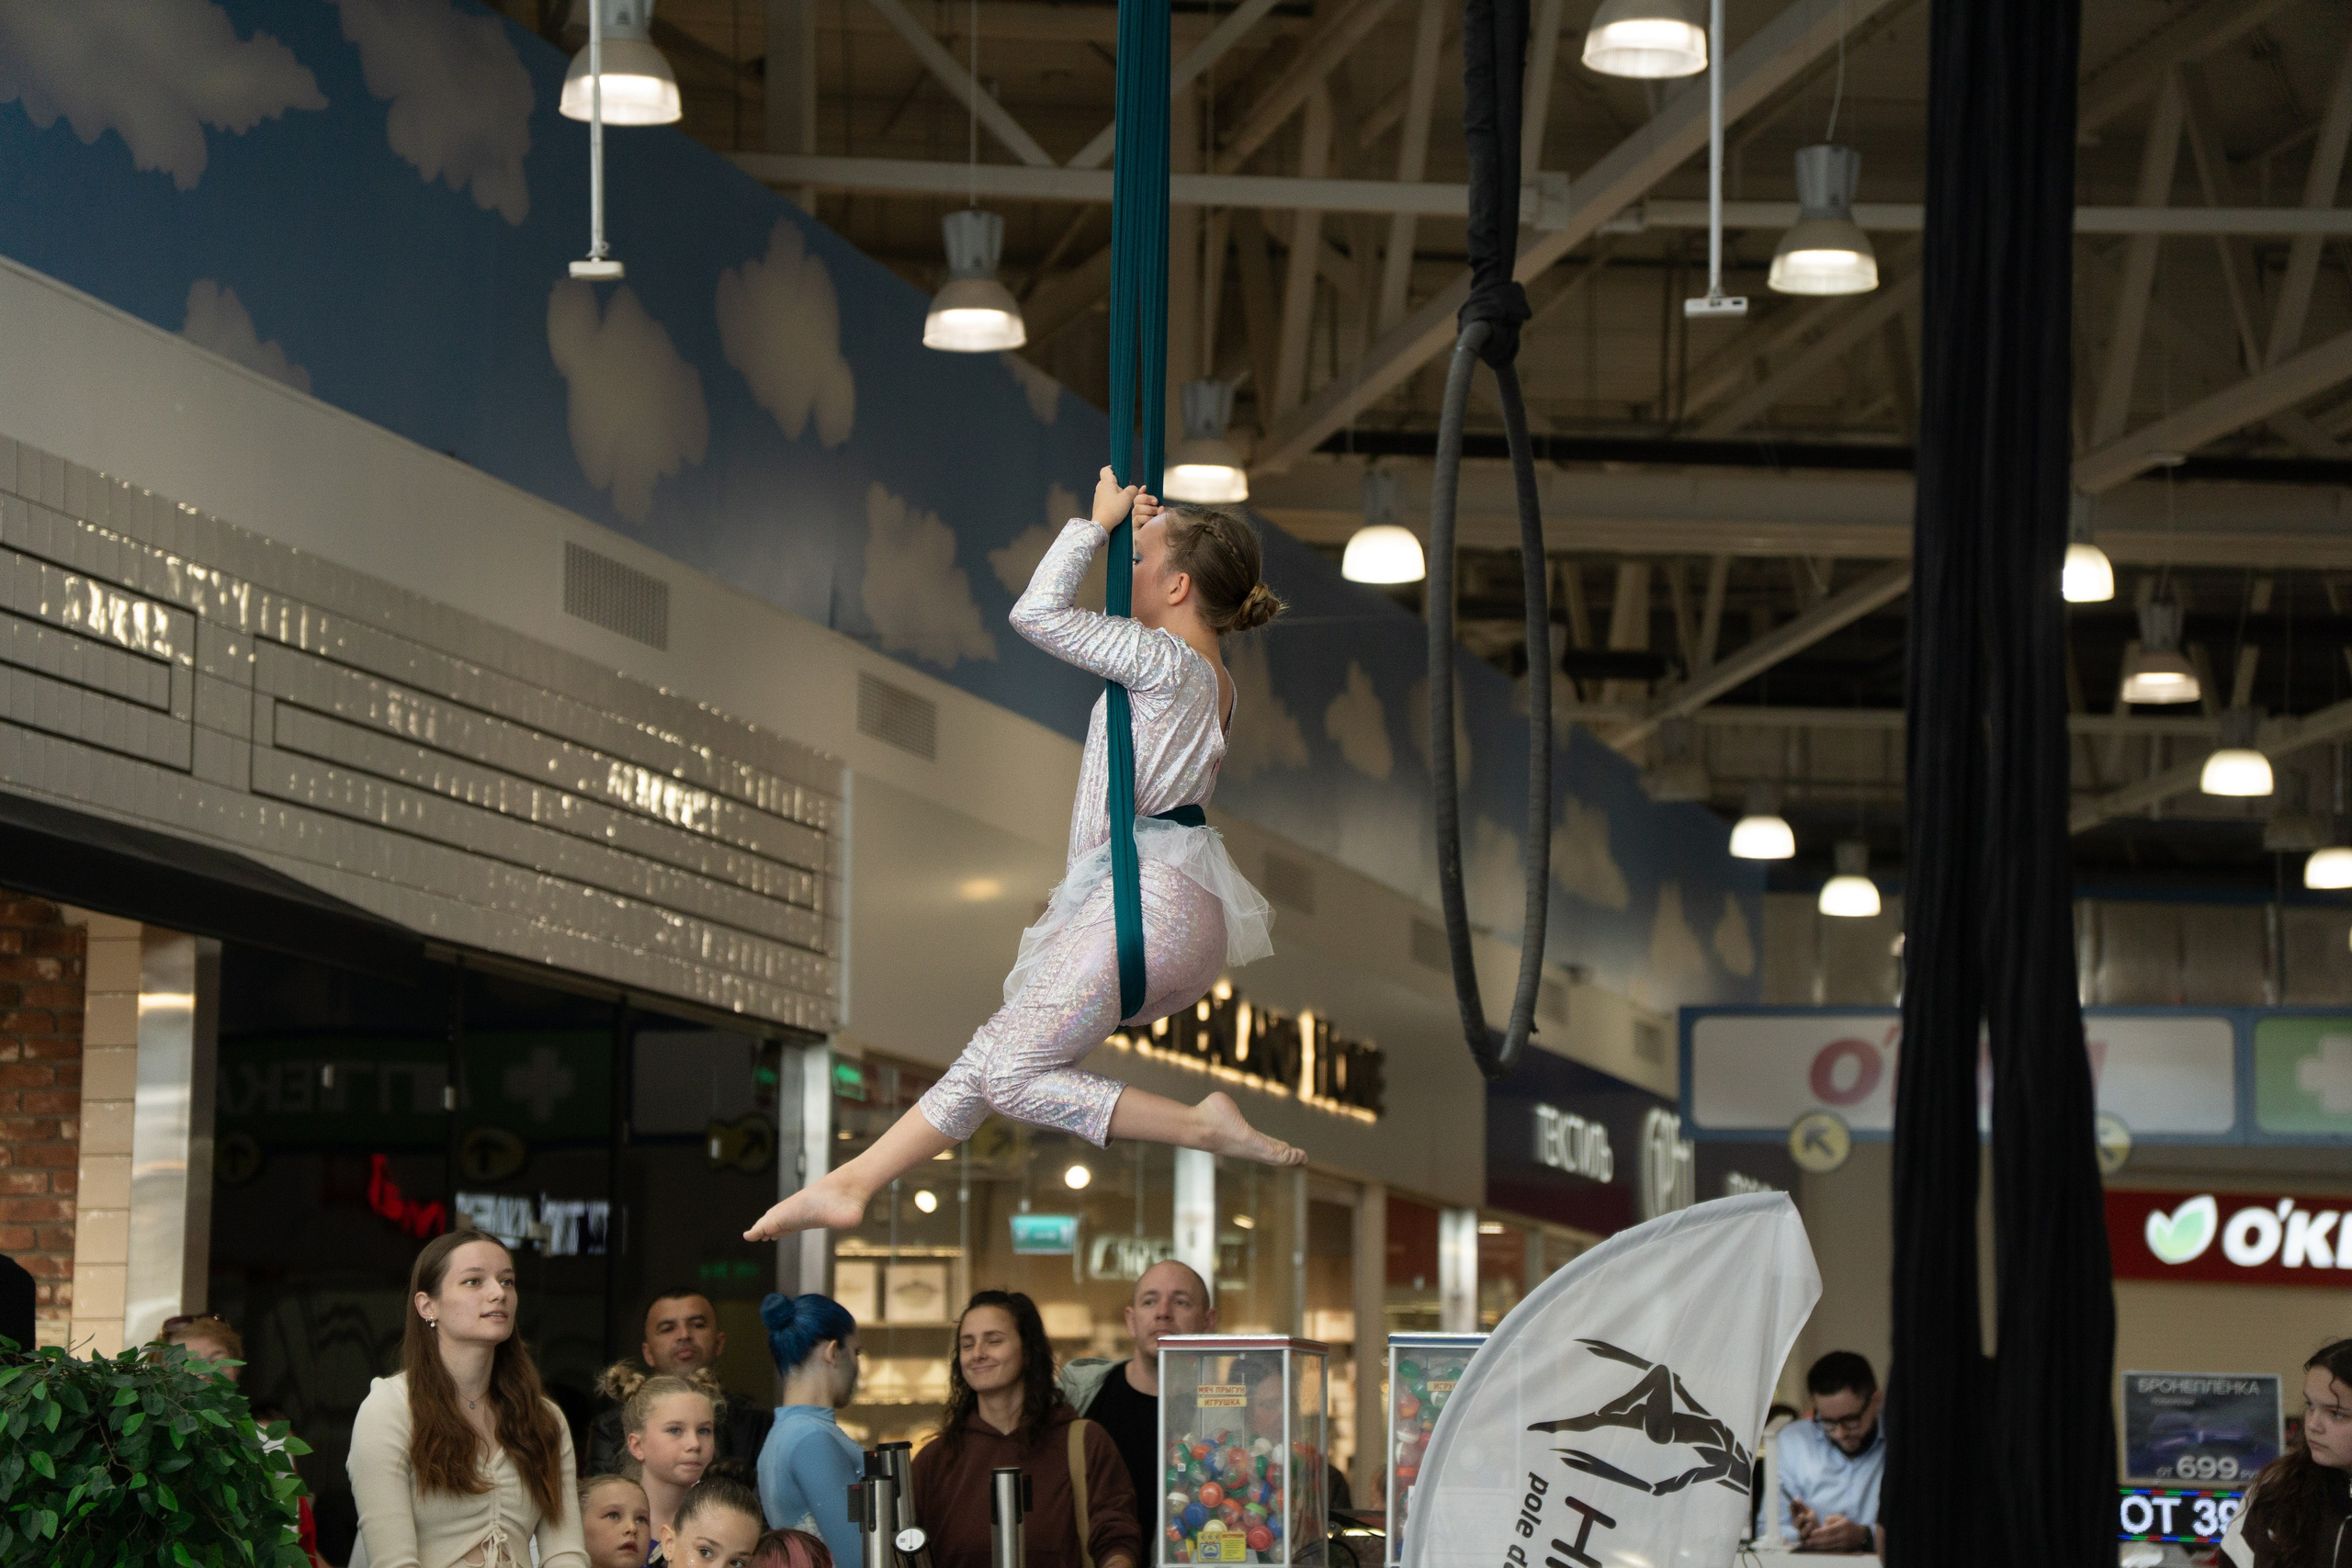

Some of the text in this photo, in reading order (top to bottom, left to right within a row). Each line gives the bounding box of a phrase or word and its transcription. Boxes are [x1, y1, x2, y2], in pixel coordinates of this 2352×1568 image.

[2177, 1456, 2239, 1480] 699
[1516, 1472, 1549, 1539] pole
[2120, 1495, 2181, 1534] ОТ
